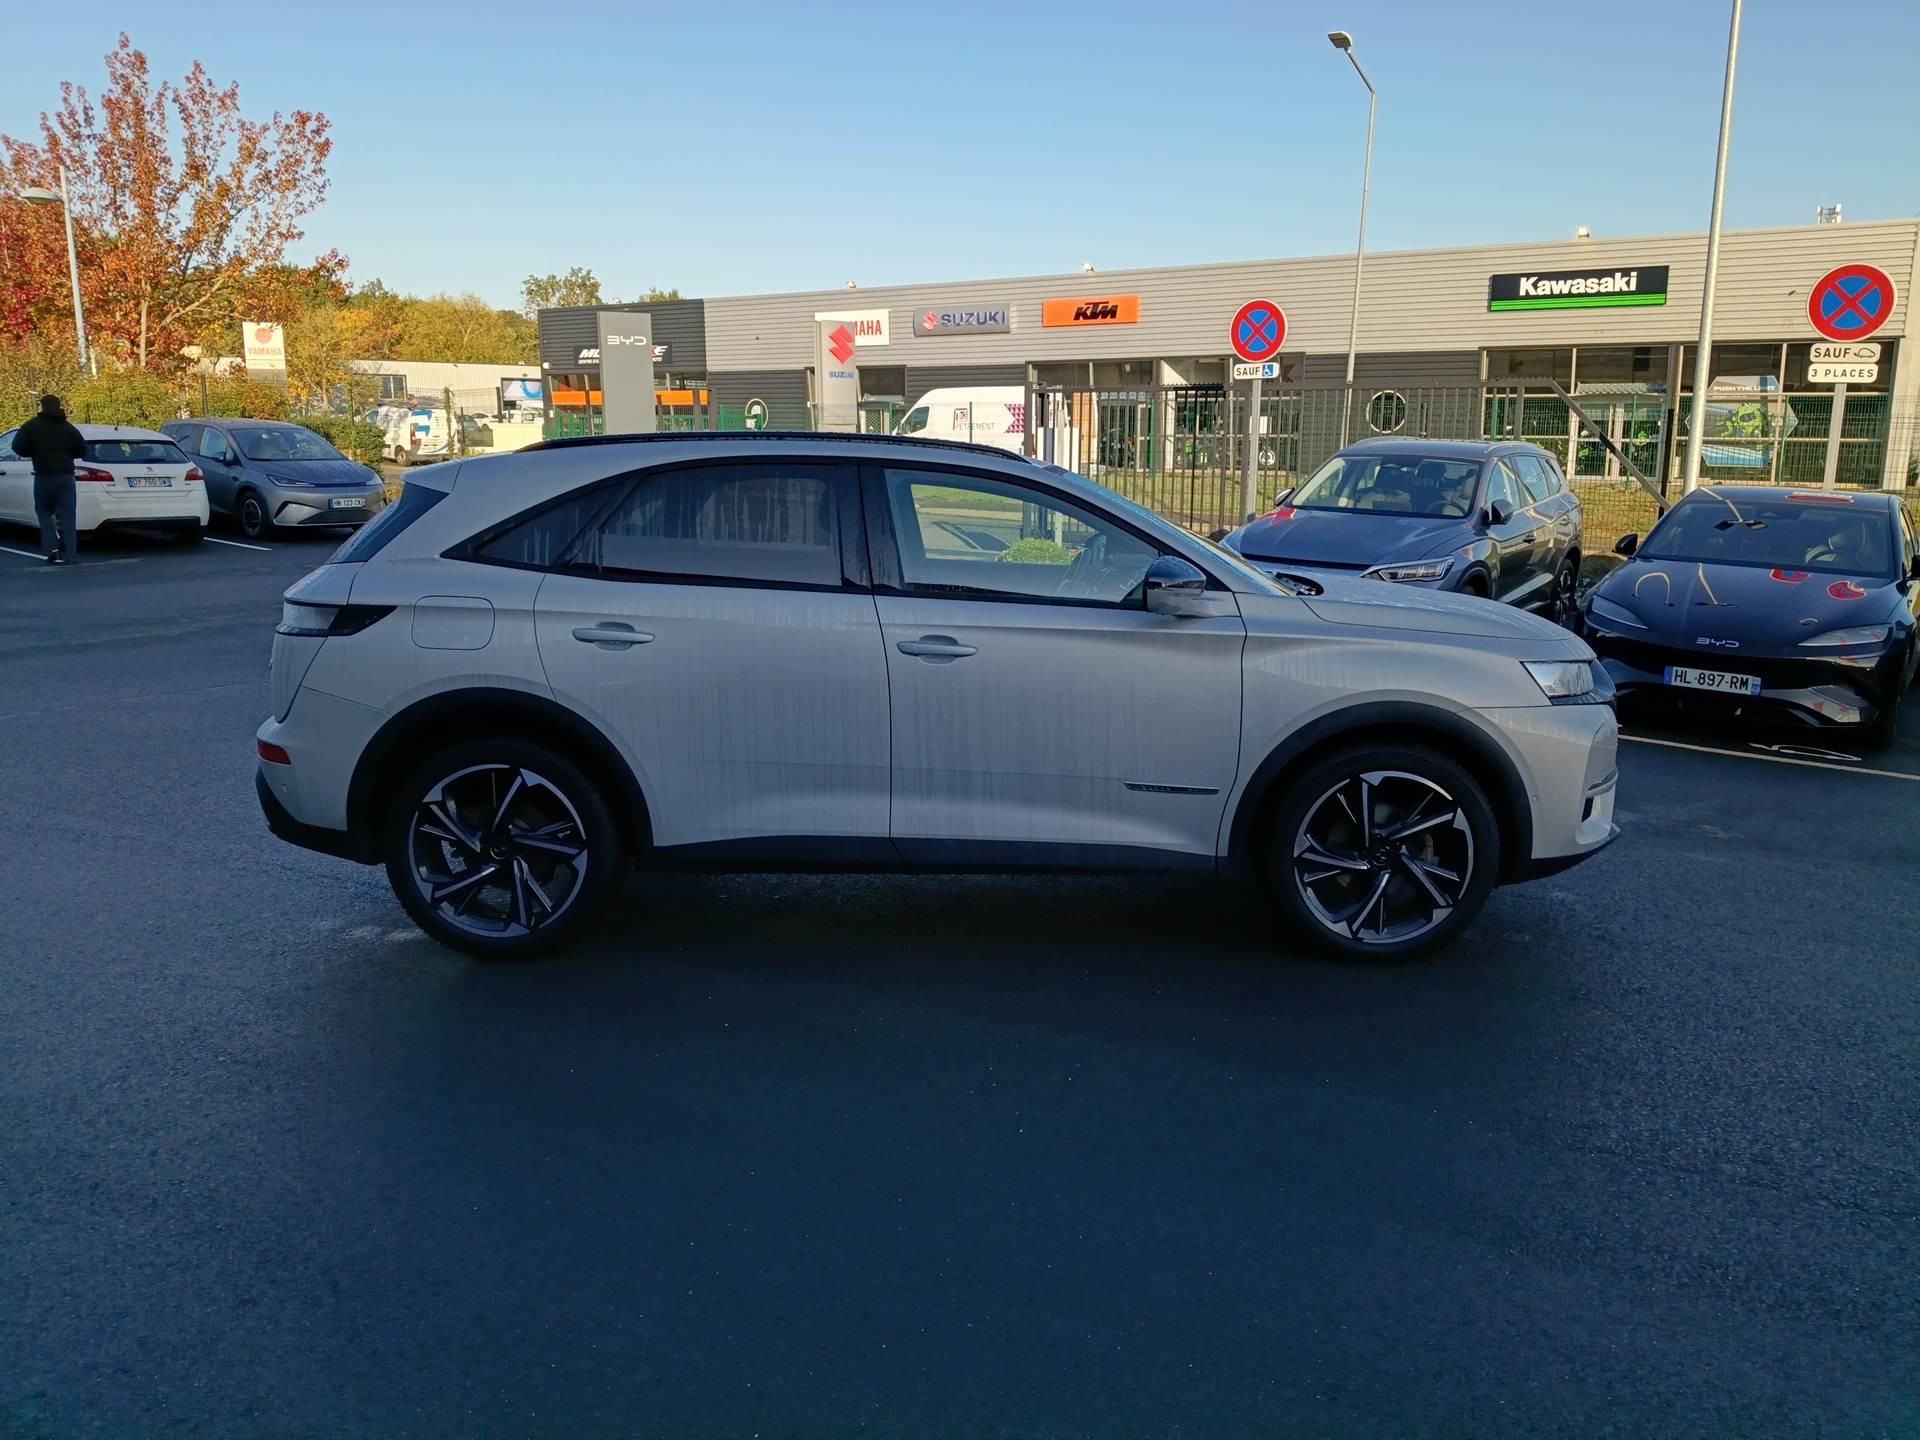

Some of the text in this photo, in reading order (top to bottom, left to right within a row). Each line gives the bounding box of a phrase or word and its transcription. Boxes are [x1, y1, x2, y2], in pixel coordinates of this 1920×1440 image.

[1519, 271, 1638, 296] Kawasaki
[1073, 301, 1118, 321] KTM
[941, 311, 1007, 327] SUZUKI
[607, 335, 647, 346] BYD
[1814, 347, 1852, 359] SAUF
[1236, 366, 1261, 376] SAUF
[1811, 368, 1874, 378] 3 PLACES
[1696, 637, 1740, 648] BYD
